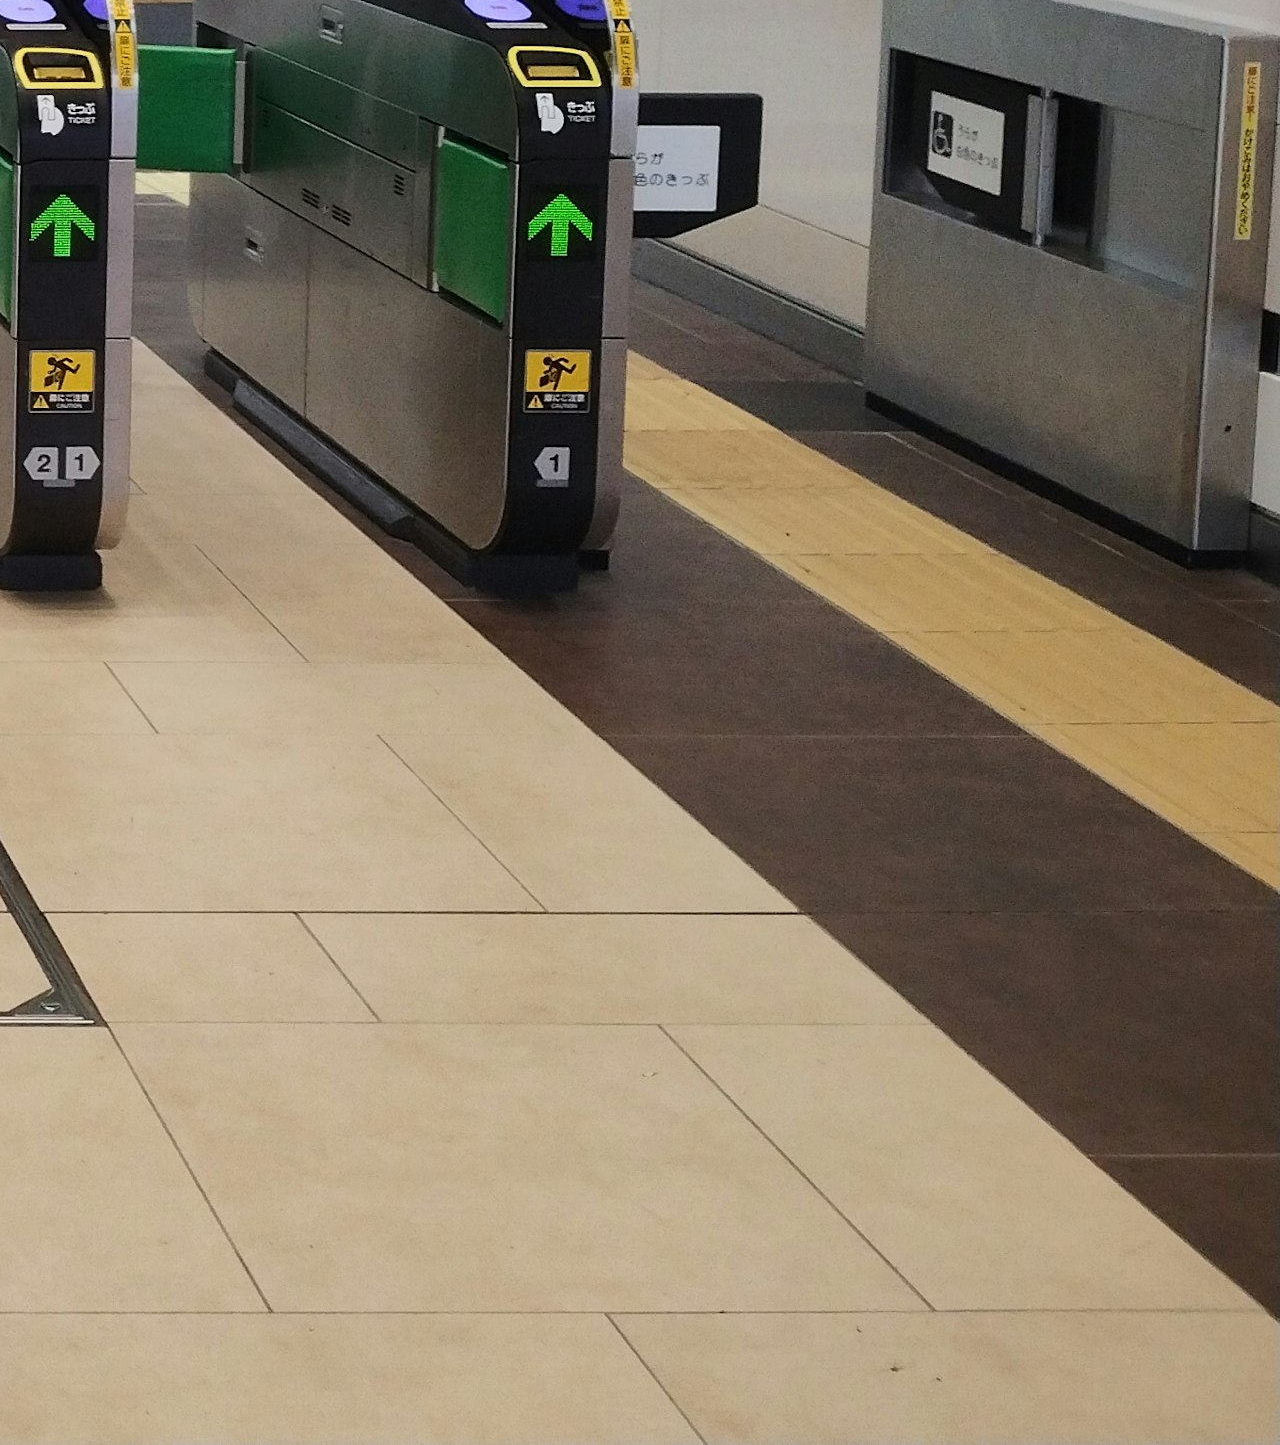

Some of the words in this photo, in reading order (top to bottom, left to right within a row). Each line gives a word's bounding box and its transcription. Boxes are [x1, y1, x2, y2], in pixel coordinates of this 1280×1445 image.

[66, 102, 97, 115] きっぷ
[566, 101, 596, 114] きっぷ
[36, 454, 51, 473] 2
[73, 454, 84, 473] 1
[548, 454, 560, 473] 1
